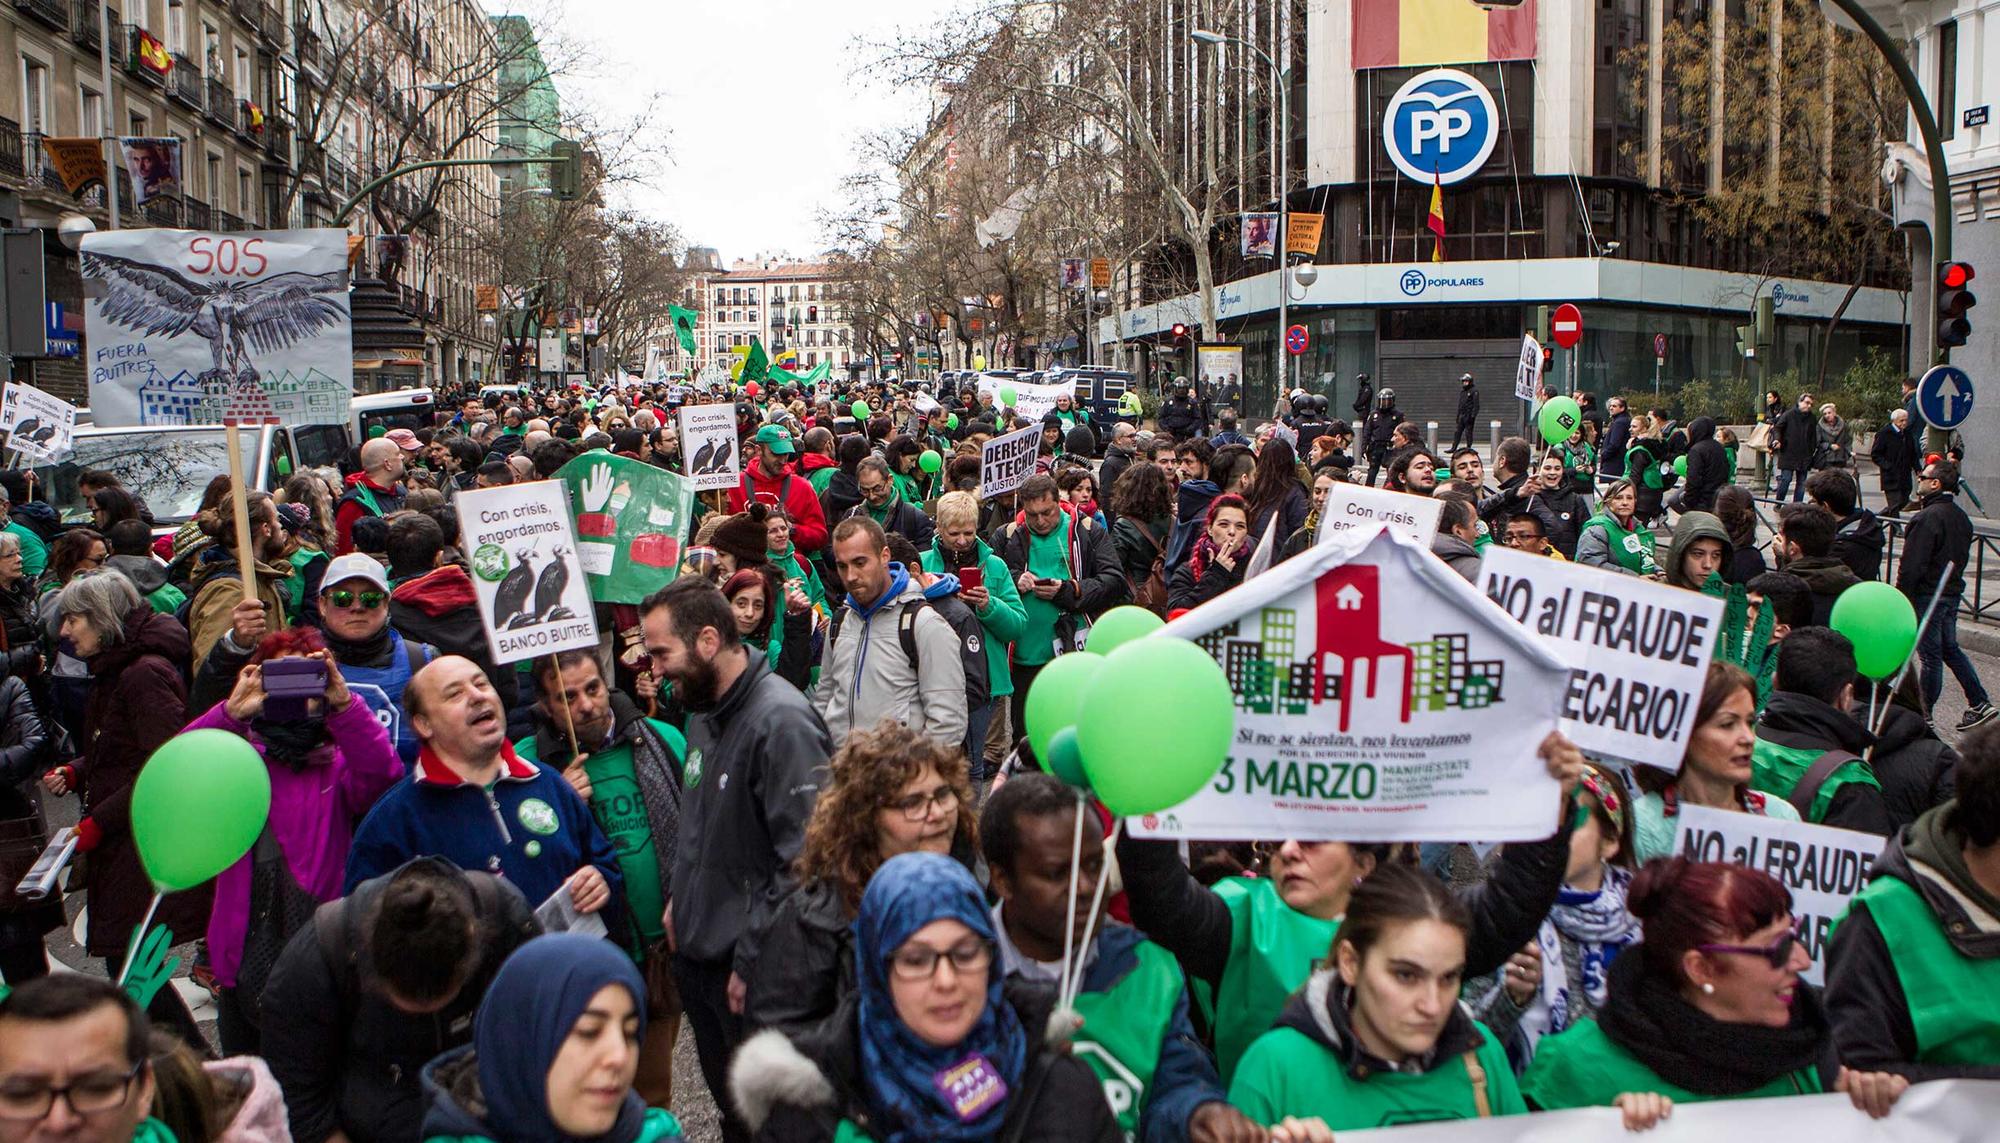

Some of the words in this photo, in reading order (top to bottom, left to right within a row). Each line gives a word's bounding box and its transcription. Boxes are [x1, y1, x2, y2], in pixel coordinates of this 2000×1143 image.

[1411, 109, 1472, 155] PP
[1405, 277, 1421, 290] PP
[1428, 278, 1484, 287] POPULARES
[97, 343, 148, 363] FUERA
[94, 358, 158, 384] BUITRES
[691, 415, 707, 423] Con
[985, 431, 1039, 465] DERECHO
[984, 467, 996, 484] A
[996, 449, 1036, 480] TECHO
[695, 477, 717, 486] ANCO
[984, 486, 990, 495] A
[990, 476, 1015, 492] JUSTO
[480, 507, 509, 524] Con
[513, 502, 552, 518] crisis,
[1346, 502, 1373, 518] Con
[477, 520, 564, 546] engordamos.
[1487, 573, 1532, 625] NO
[1537, 587, 1572, 638] al
[1574, 591, 1708, 668] FRAUDE
[499, 631, 548, 654] BANCO
[1562, 667, 1690, 743] ECARIO!
[1214, 756, 1236, 794] 3
[1245, 758, 1377, 800] MARZO
[597, 792, 645, 820] TOP
[1685, 827, 1725, 864] NO
[1733, 836, 1759, 871] al
[1765, 838, 1877, 896] FRAUDE
